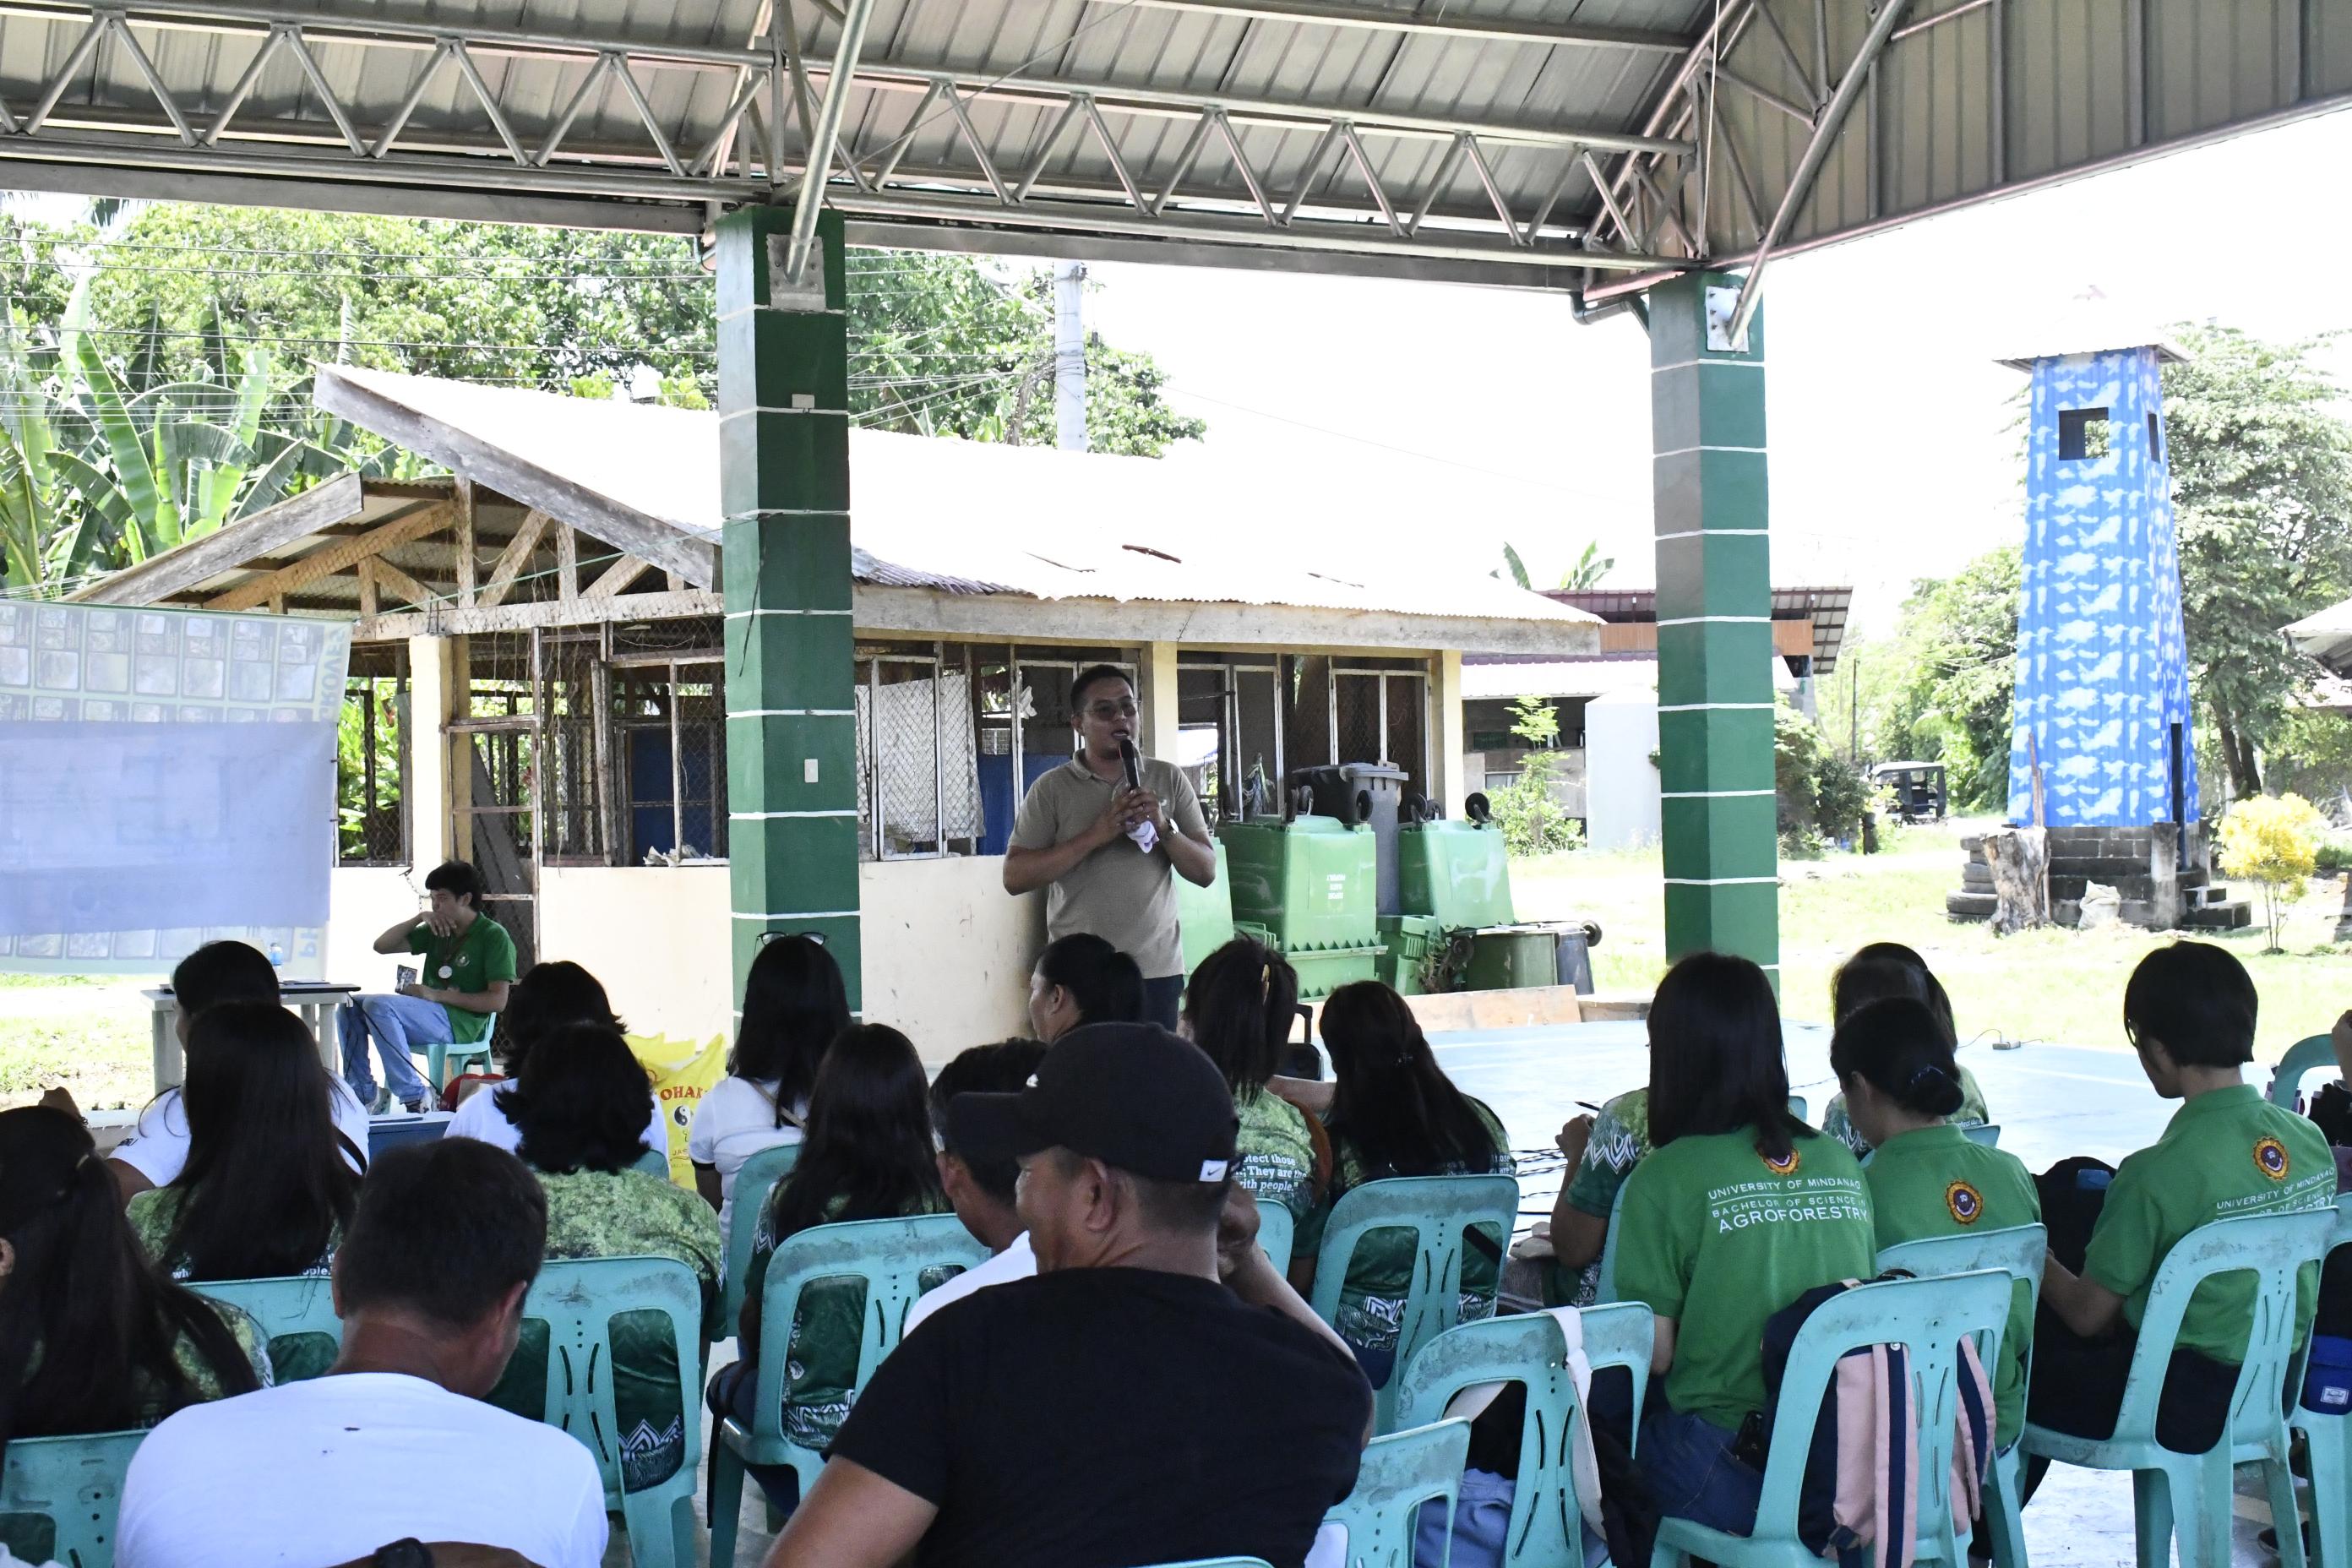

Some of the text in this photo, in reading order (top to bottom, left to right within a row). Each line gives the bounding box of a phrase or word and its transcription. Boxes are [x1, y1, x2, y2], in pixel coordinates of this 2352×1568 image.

[1247, 1166, 1275, 1179] They
[1277, 1168, 1293, 1178] are
[1708, 1178, 1861, 1200] UNIVERSITY OF MINDANAO
[2216, 1190, 2279, 1210] UNIVERSITY
[2284, 1184, 2295, 1195] OF
[2297, 1167, 2335, 1189] MINDANAO
[1712, 1200, 1779, 1217] BACHELOR
[1786, 1198, 1801, 1207] OF
[1809, 1195, 1856, 1206] SCIENCE
[1719, 1206, 1868, 1233] AGROFORESTRY
